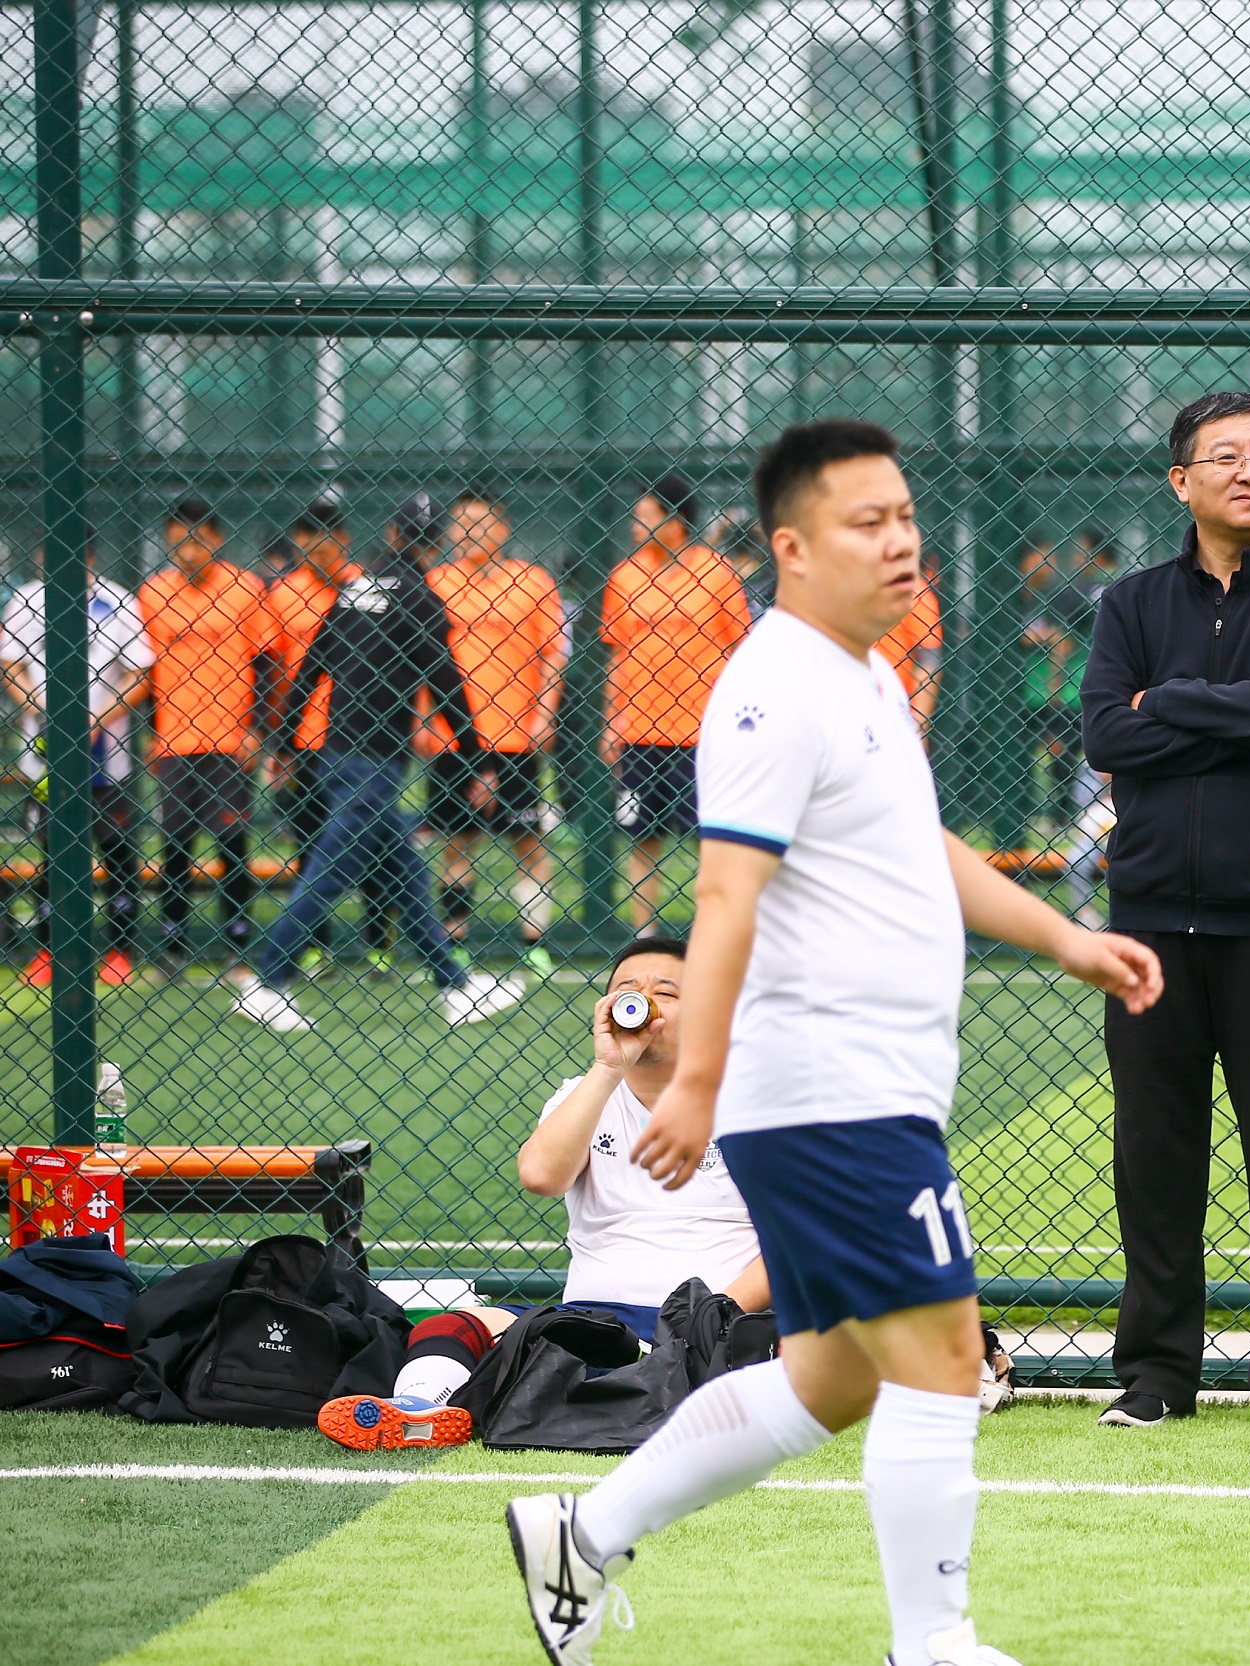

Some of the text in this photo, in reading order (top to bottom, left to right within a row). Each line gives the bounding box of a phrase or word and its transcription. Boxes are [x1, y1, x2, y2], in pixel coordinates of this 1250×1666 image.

[592, 1145, 618, 1158] KELME
[908, 1180, 973, 1268] 11
[258, 1341, 293, 1353] KELME
